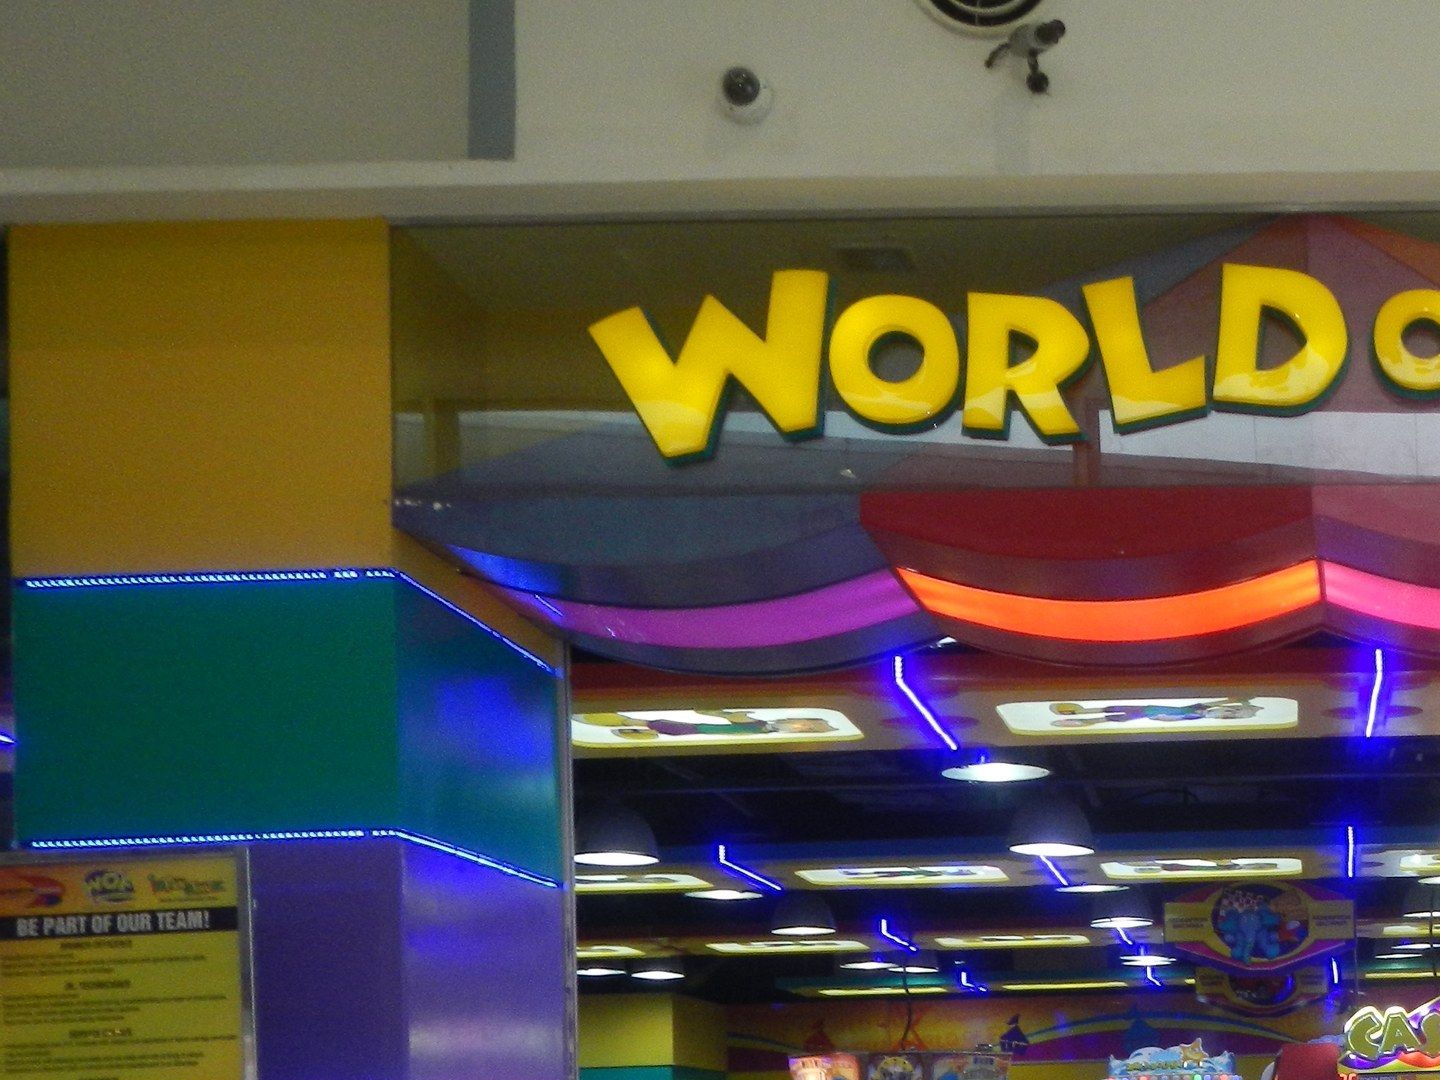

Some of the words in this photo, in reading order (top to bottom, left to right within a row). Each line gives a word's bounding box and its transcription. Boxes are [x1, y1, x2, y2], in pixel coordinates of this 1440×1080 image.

[588, 263, 1348, 465] WORLD
[17, 917, 39, 936] BE
[44, 916, 86, 936] PART
[92, 914, 111, 933] OF
[117, 913, 151, 933] OUR
[157, 910, 209, 930] TEAM!
